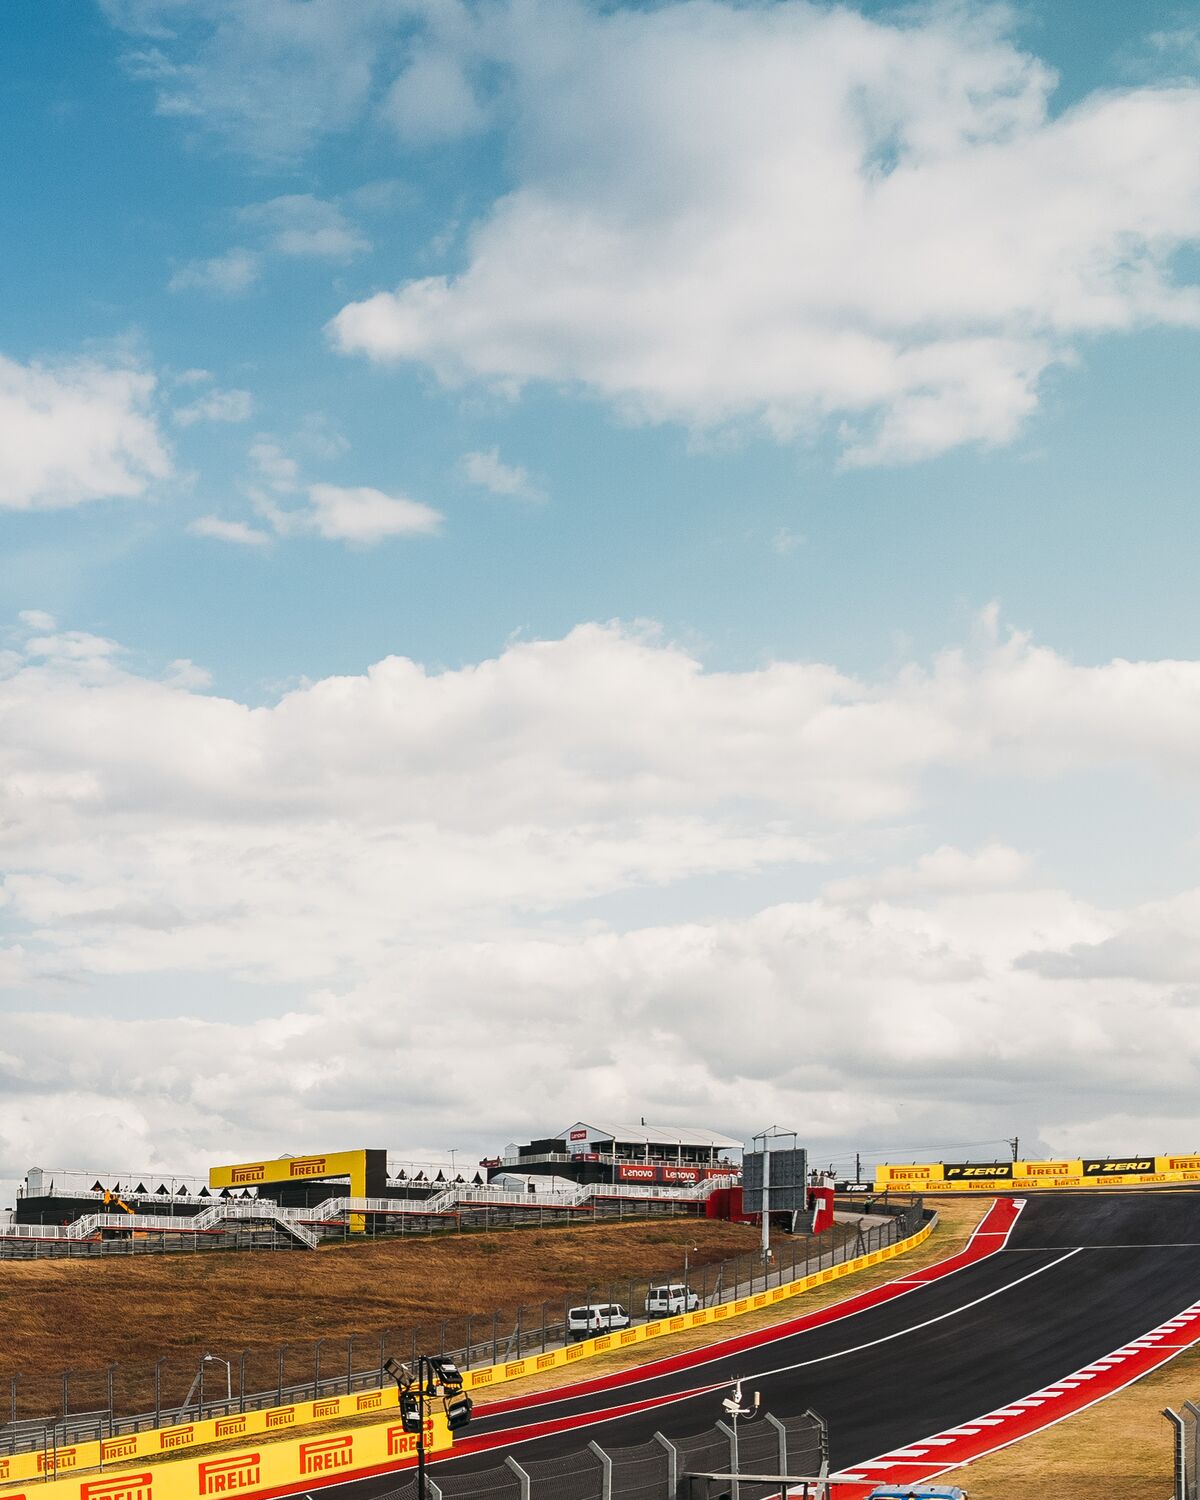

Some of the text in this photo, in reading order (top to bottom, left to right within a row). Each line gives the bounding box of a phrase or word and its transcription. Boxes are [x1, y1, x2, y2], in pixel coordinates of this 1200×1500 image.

[231, 1165, 265, 1183] PIRELLI
[290, 1158, 326, 1177] PIRELLI
[623, 1166, 653, 1178] Lenovo
[665, 1168, 696, 1180] Lenovo
[889, 1168, 930, 1180] PIRELLI
[962, 1167, 1009, 1176] ZERO
[1026, 1163, 1069, 1176] PIRELLI
[1087, 1162, 1151, 1172] P ZERO
[472, 1368, 493, 1385] PIRELLI
[313, 1399, 340, 1418] PIRELLI
[356, 1392, 382, 1410] PIRELLI
[266, 1407, 295, 1427] PIRELLI
[215, 1416, 246, 1437] PIRELLI
[160, 1426, 194, 1449] PIRELLI
[101, 1437, 137, 1460] PIRELLI
[300, 1435, 353, 1474] PIRELLI
[37, 1448, 76, 1472] PIRELLI
[199, 1453, 260, 1495] PIRELLI
